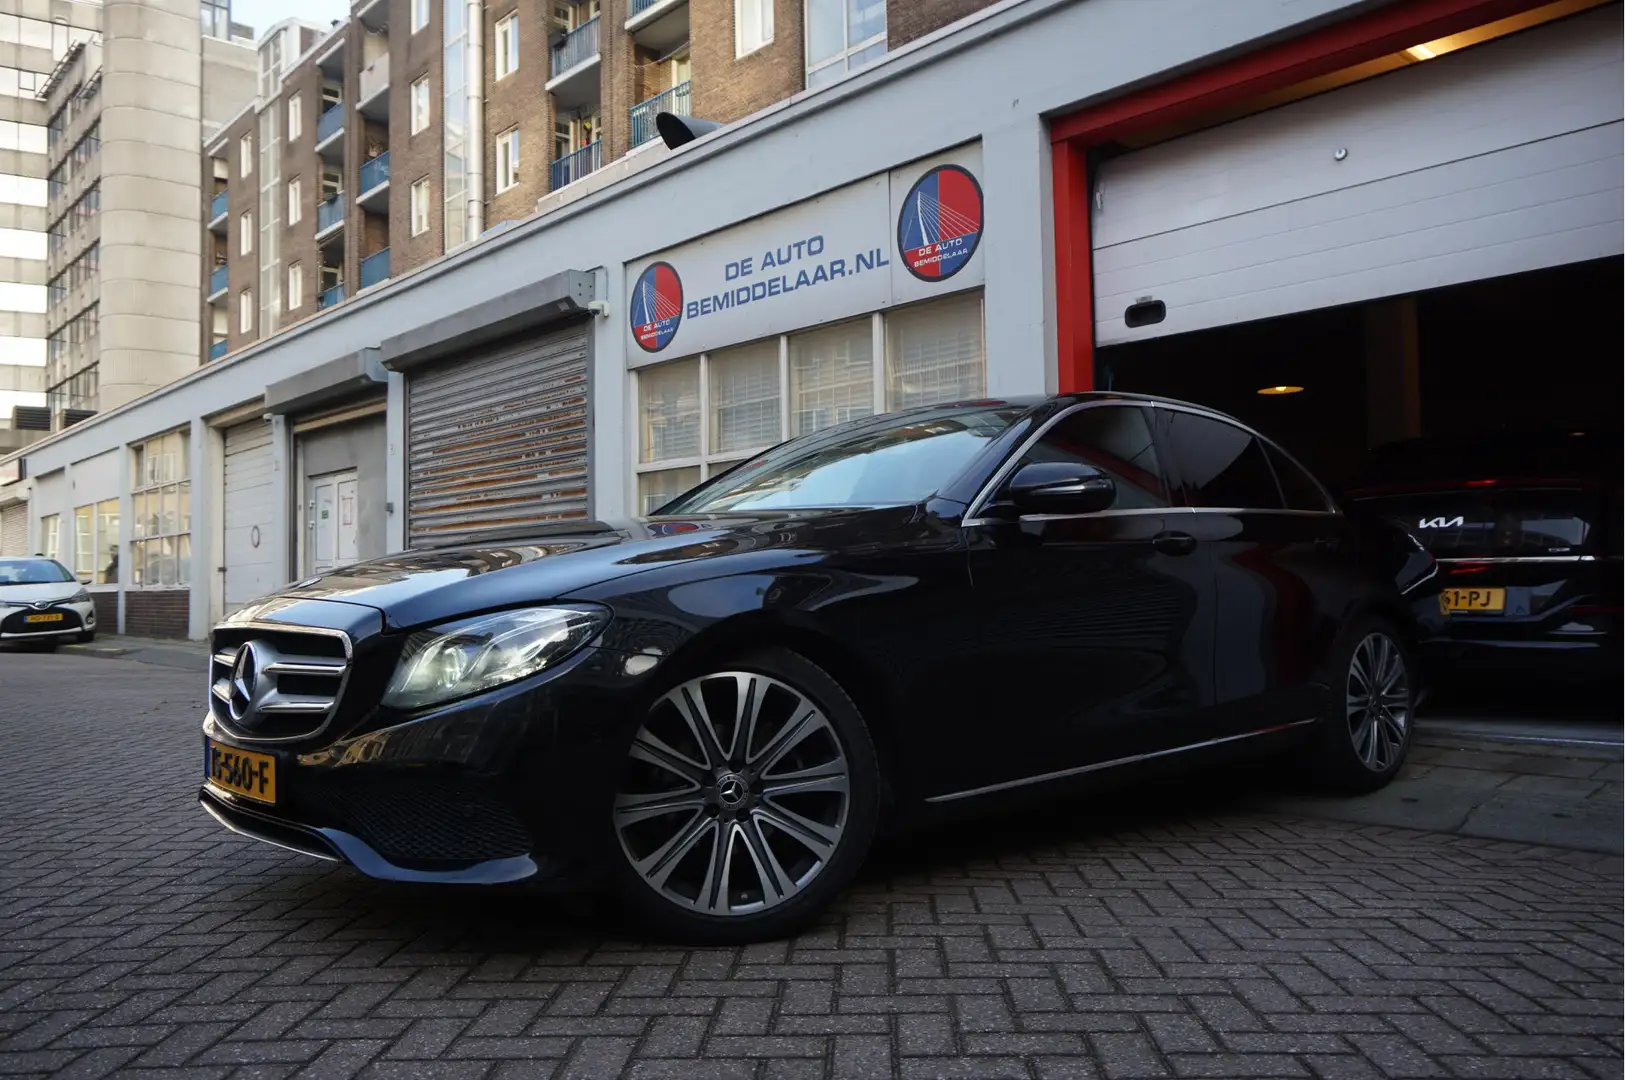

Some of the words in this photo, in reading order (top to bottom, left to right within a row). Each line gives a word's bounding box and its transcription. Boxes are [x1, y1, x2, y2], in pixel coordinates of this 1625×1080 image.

[918, 246, 932, 257] DE
[934, 237, 963, 253] AUTO
[725, 256, 754, 282] DE
[760, 234, 825, 271] AUTO
[913, 247, 968, 268] BEMIDDELAAR
[686, 247, 890, 320] BEMIDDELAAR.NL
[640, 327, 673, 341] BEMIDDELAAR
[643, 324, 652, 332] DE
[653, 319, 671, 329] AUTO
[1419, 515, 1464, 529] KIA
